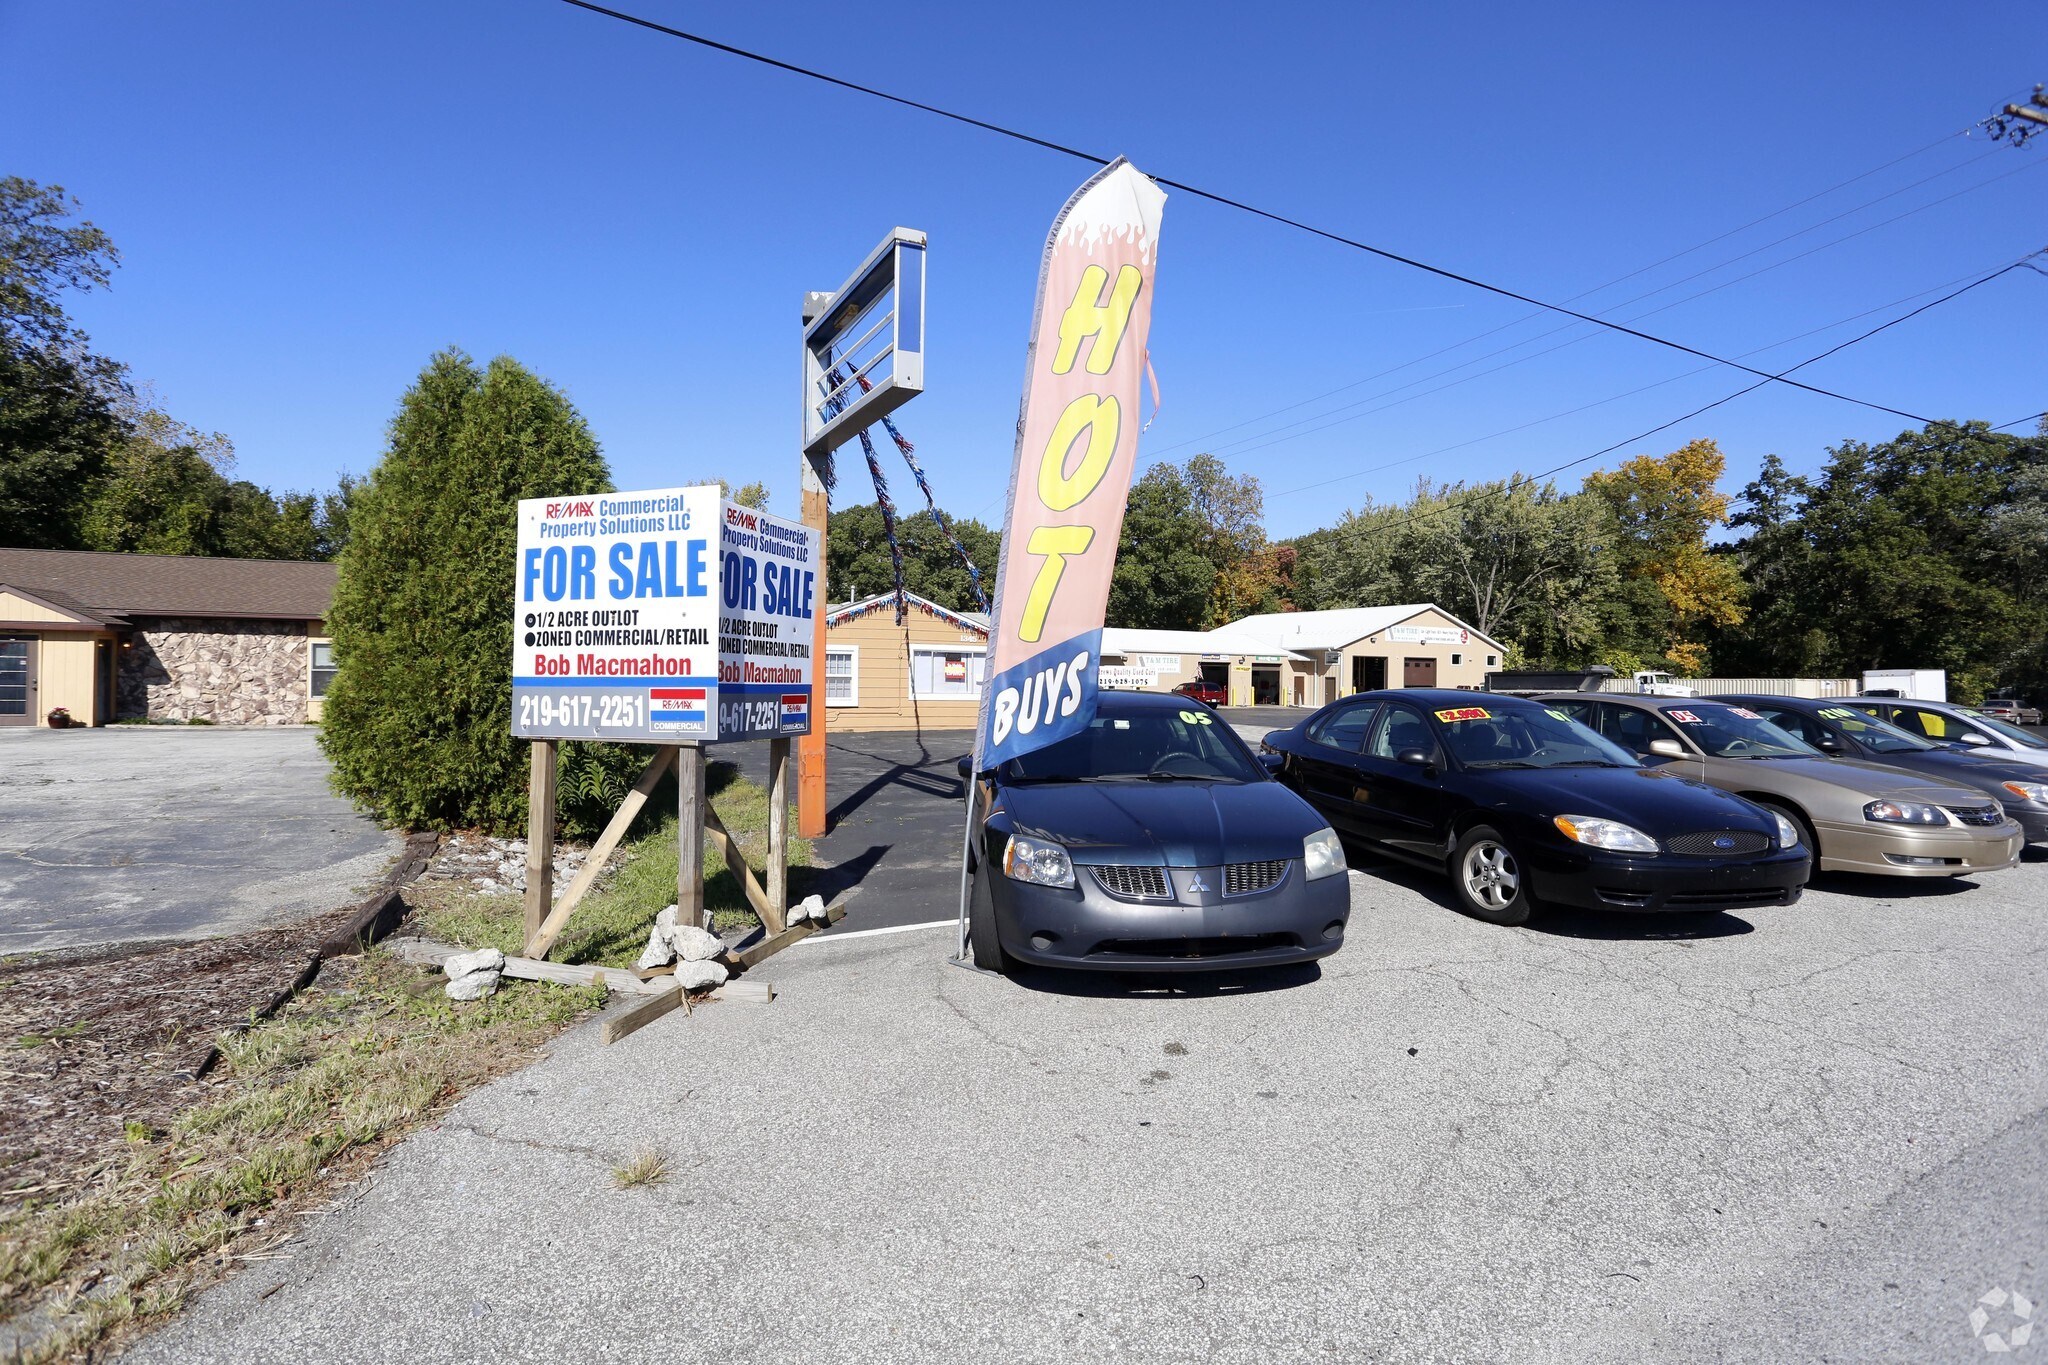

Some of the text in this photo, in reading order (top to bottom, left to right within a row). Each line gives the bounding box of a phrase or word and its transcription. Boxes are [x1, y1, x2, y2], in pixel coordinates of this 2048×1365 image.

[1018, 264, 1143, 643] HOT
[546, 494, 684, 520] RE/MAX Commercial
[540, 513, 691, 538] Property Solutions LLC
[727, 508, 807, 546] RE/MAX Commercial
[723, 525, 808, 563] Property Solutions LLC
[524, 539, 708, 602] FOR SALE
[763, 561, 814, 619] SALE
[536, 609, 639, 628] 1/2 ACRE OUTLOT
[731, 619, 751, 636] ACRE
[752, 621, 778, 639] OUTLOT
[536, 628, 709, 647] ZONED COMMERCIAL/RETAIL
[742, 639, 809, 659] COMMERCIAL/RETAIL
[535, 653, 692, 676] Bob Macmahon
[1162, 656, 1179, 664] TIRE
[744, 661, 802, 684] Macmahon
[1113, 668, 1131, 677] Quality
[1133, 668, 1144, 676] Used
[1145, 668, 1156, 676] Cars
[520, 694, 644, 727] 219-617-2251
[662, 700, 693, 709] RE/MAX
[993, 651, 1089, 747] BUYS
[654, 721, 702, 730] COMMERCIAL
[1179, 711, 1213, 725] 05
[1670, 711, 1697, 721] 05
